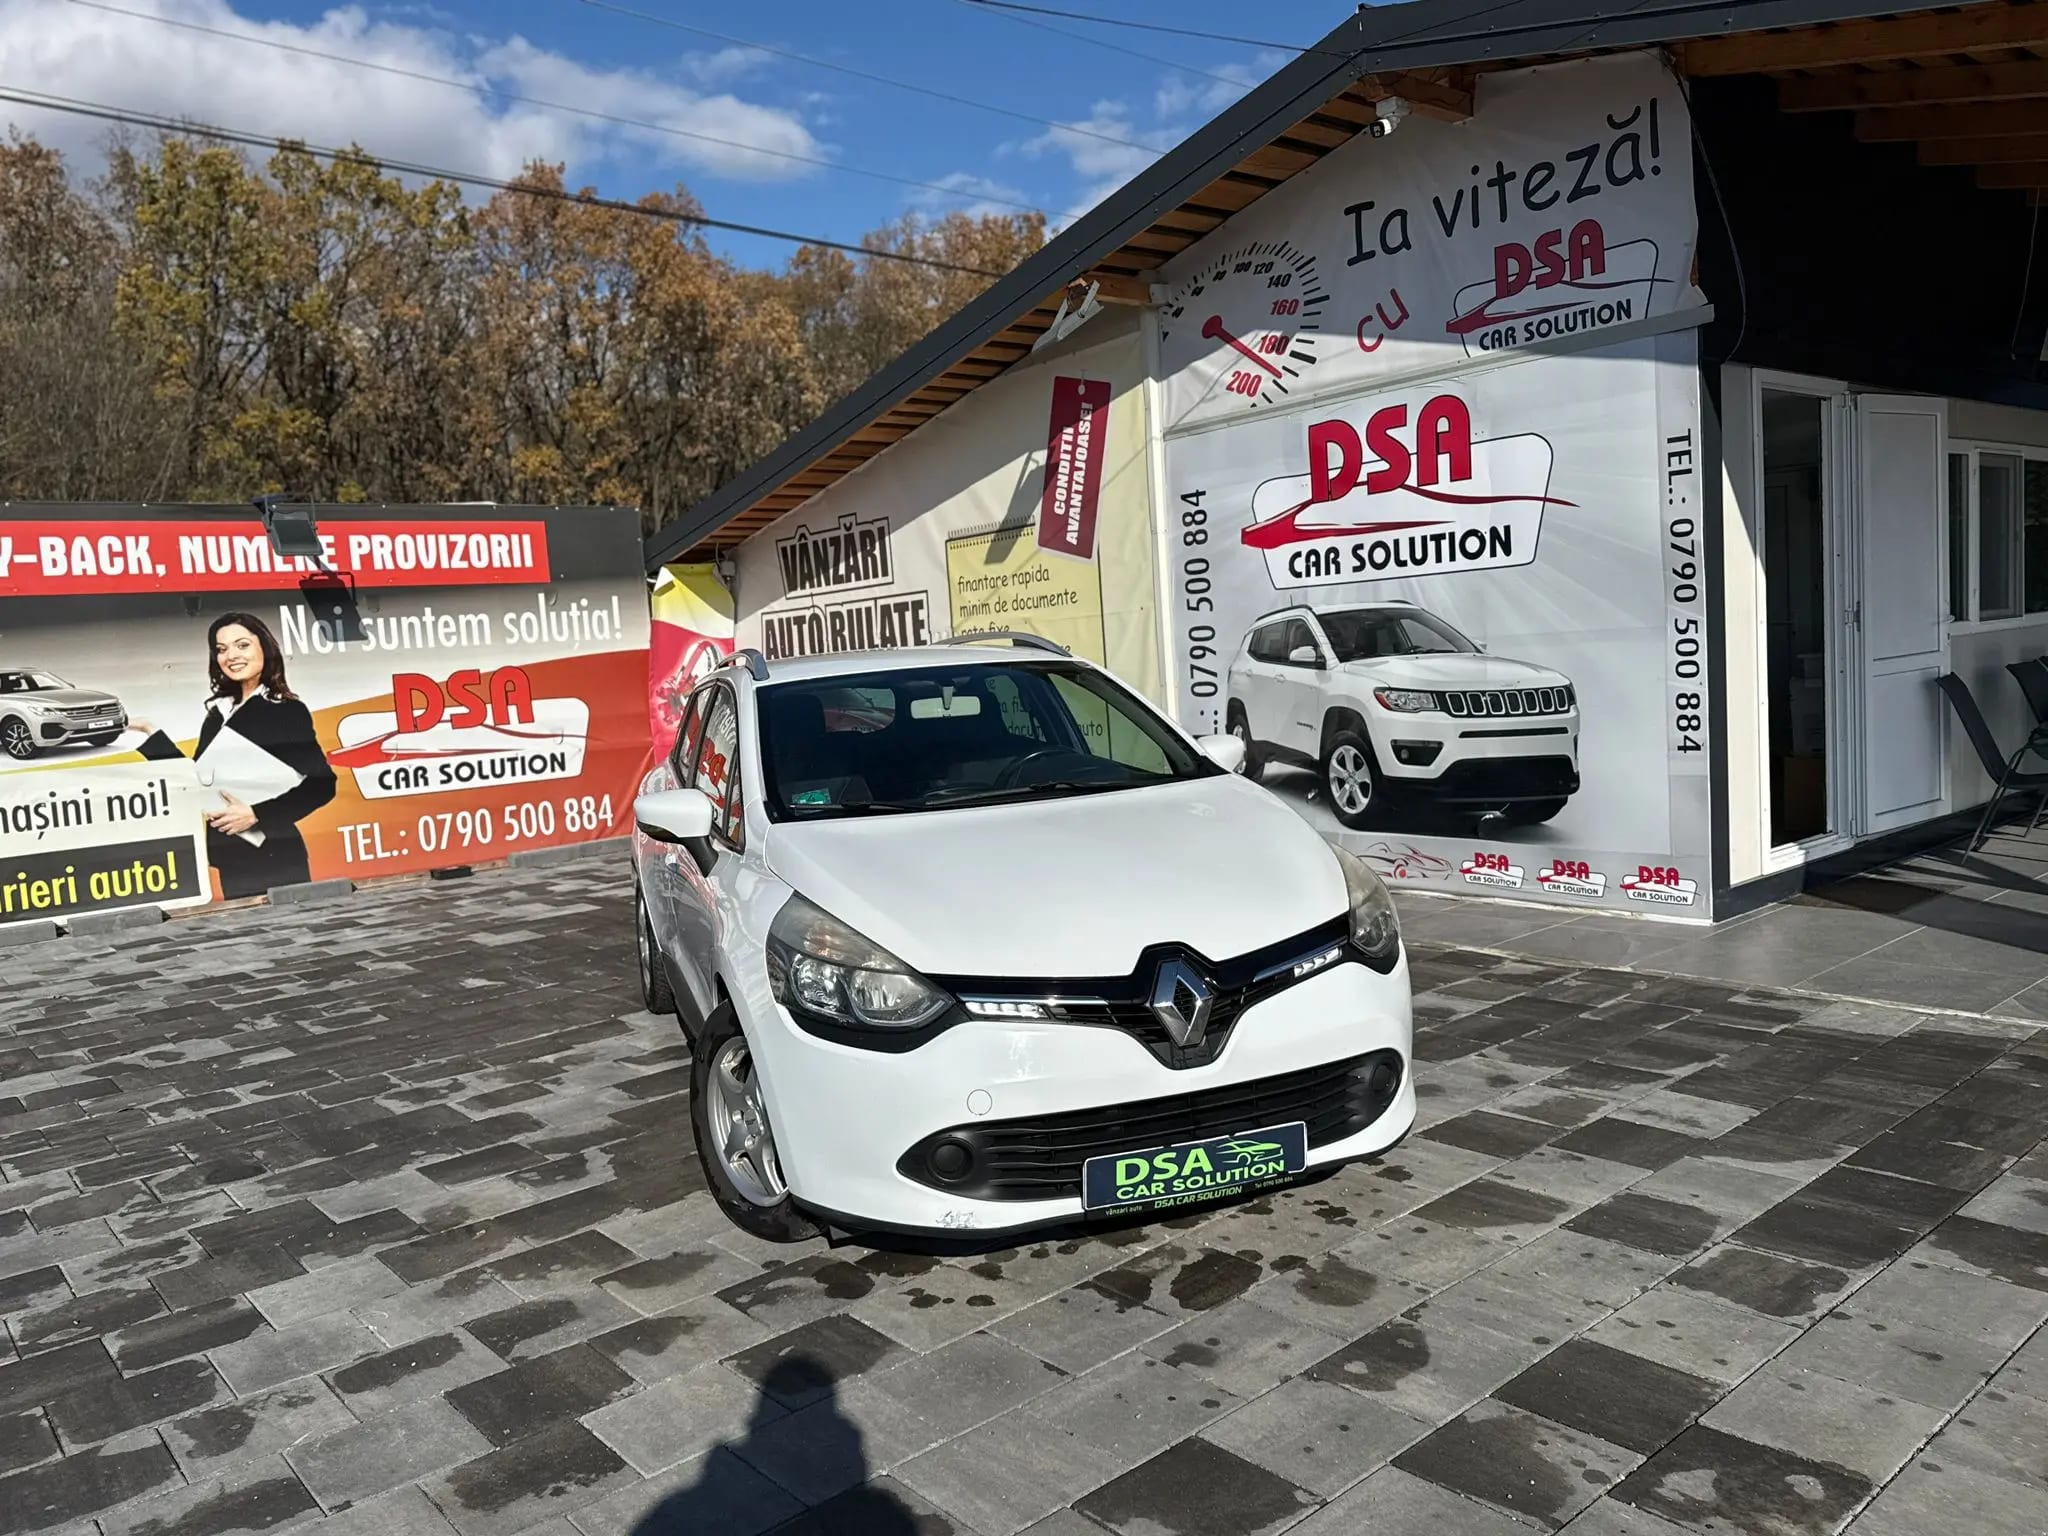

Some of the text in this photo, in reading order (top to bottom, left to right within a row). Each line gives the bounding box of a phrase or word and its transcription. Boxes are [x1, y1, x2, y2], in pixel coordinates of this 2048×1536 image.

[1344, 98, 1661, 266] Ia viteză!
[1233, 261, 1252, 273] 100
[1253, 261, 1275, 275] 120
[1267, 273, 1292, 288] 140
[1494, 219, 1606, 299] DSA
[1270, 299, 1299, 315] 160
[1357, 288, 1411, 353] cu
[1478, 298, 1632, 351] CAR SOLUTION
[1258, 335, 1290, 355] 180
[1226, 371, 1262, 397] 200
[1308, 394, 1472, 502] DSA
[1065, 402, 1093, 546] AVANTAJOASE!
[1180, 489, 1208, 546] 884
[349, 533, 534, 570] PROVIZORII
[781, 523, 889, 592] VÂNZĂRI
[1288, 524, 1512, 579] CAR SOLUTION
[1670, 518, 1698, 603] 0790
[958, 564, 1050, 595] finantare rapida
[1184, 557, 1213, 612] 500
[279, 593, 622, 655] Noi suntem soluția!
[959, 590, 1078, 617] minim de documente
[765, 599, 927, 660] AUTO RULATE
[1674, 617, 1700, 679] 500
[1188, 625, 1218, 697] 0790
[392, 666, 534, 733] DSA
[1675, 692, 1702, 753] 884
[378, 752, 566, 791] CAR SOLUTION
[107, 778, 170, 822] noi!
[337, 794, 613, 863] TEL.: 0790 500 884
[0, 851, 178, 914] rieri auto!
[1469, 875, 1517, 887] CAR SOLUTION
[1474, 852, 1509, 872] DSA
[1553, 859, 1590, 879] DSA
[1638, 865, 1680, 886] DSA
[1548, 883, 1598, 895] CAR SOLUTION
[1633, 891, 1688, 903] CAR SOLUTION
[1116, 1147, 1213, 1186] DSA
[1116, 1160, 1284, 1200] CAR SOLUTION
[1154, 1186, 1243, 1209] DSA CAR SOLUTION
